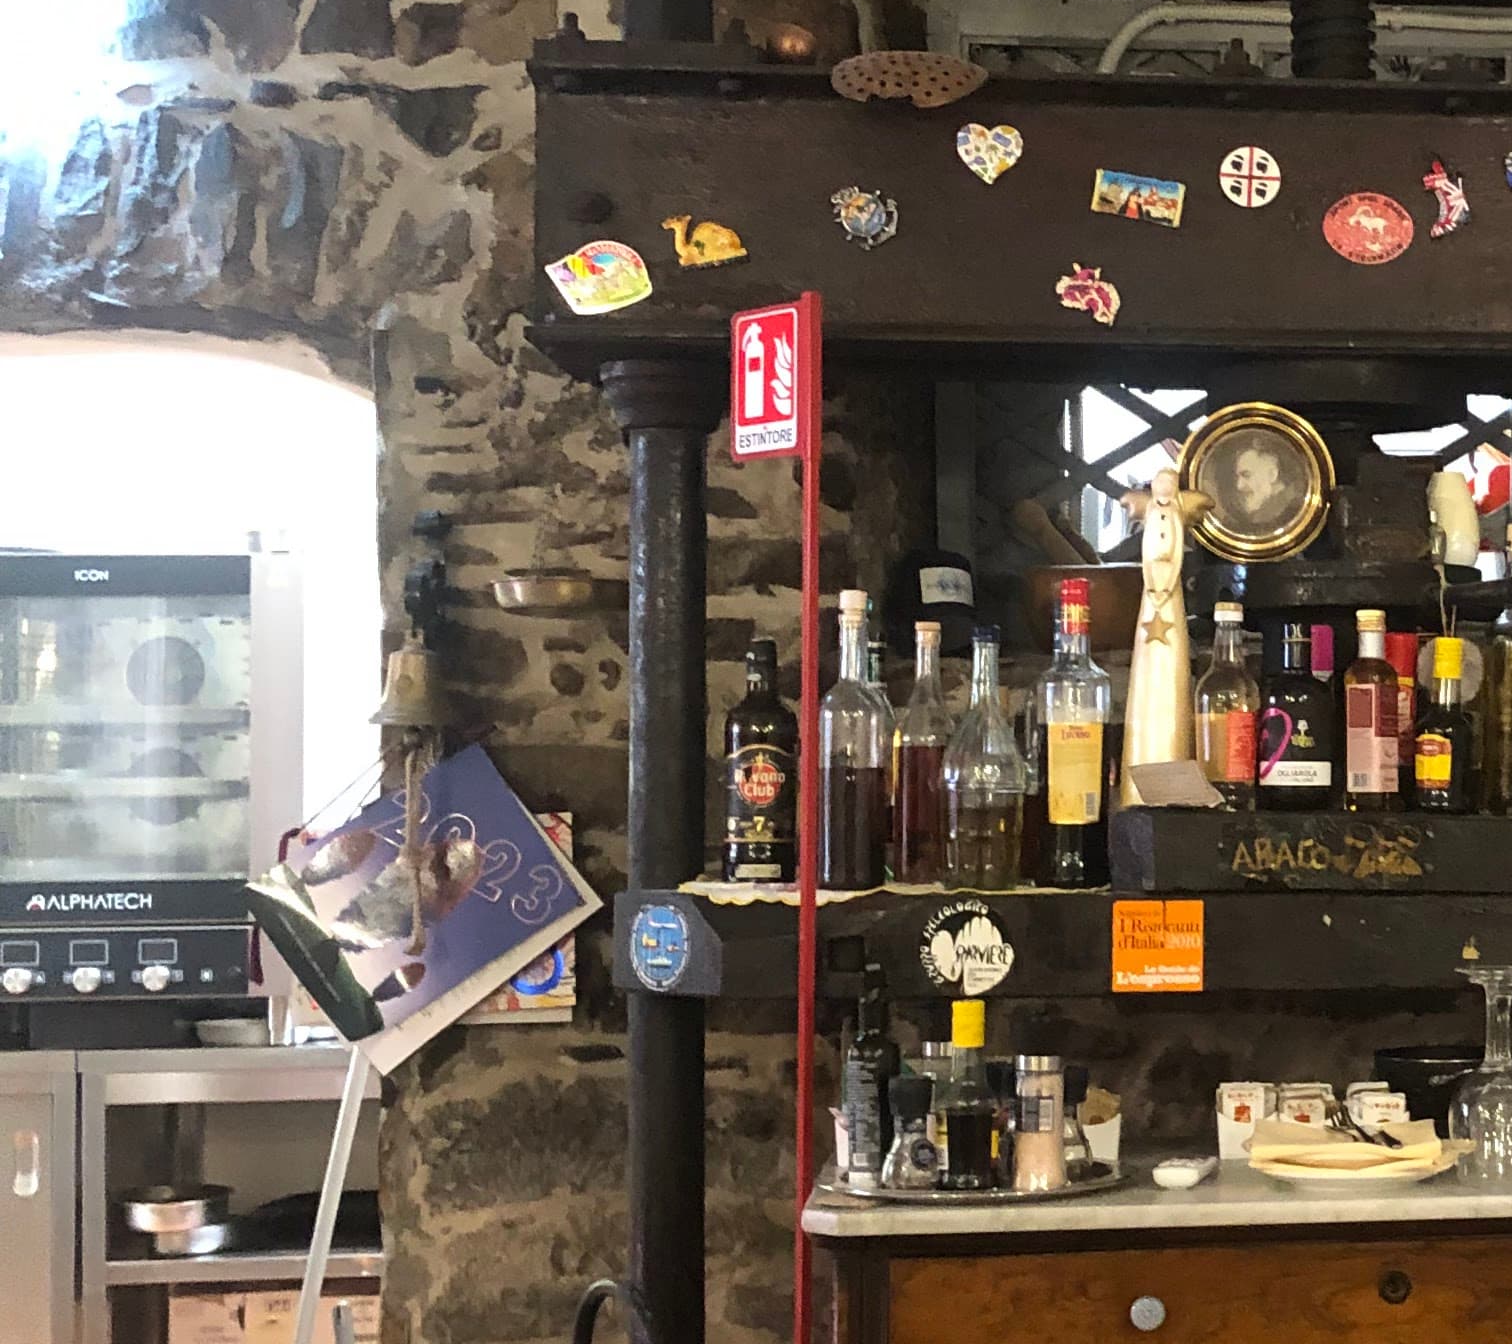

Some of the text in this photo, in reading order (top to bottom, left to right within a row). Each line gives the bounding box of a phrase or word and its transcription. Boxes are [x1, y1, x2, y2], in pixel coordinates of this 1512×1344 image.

[738, 427, 793, 449] ESTINTORE
[74, 569, 109, 581] ICON
[744, 784, 775, 796] Club
[47, 892, 152, 911] ALPHATECH
